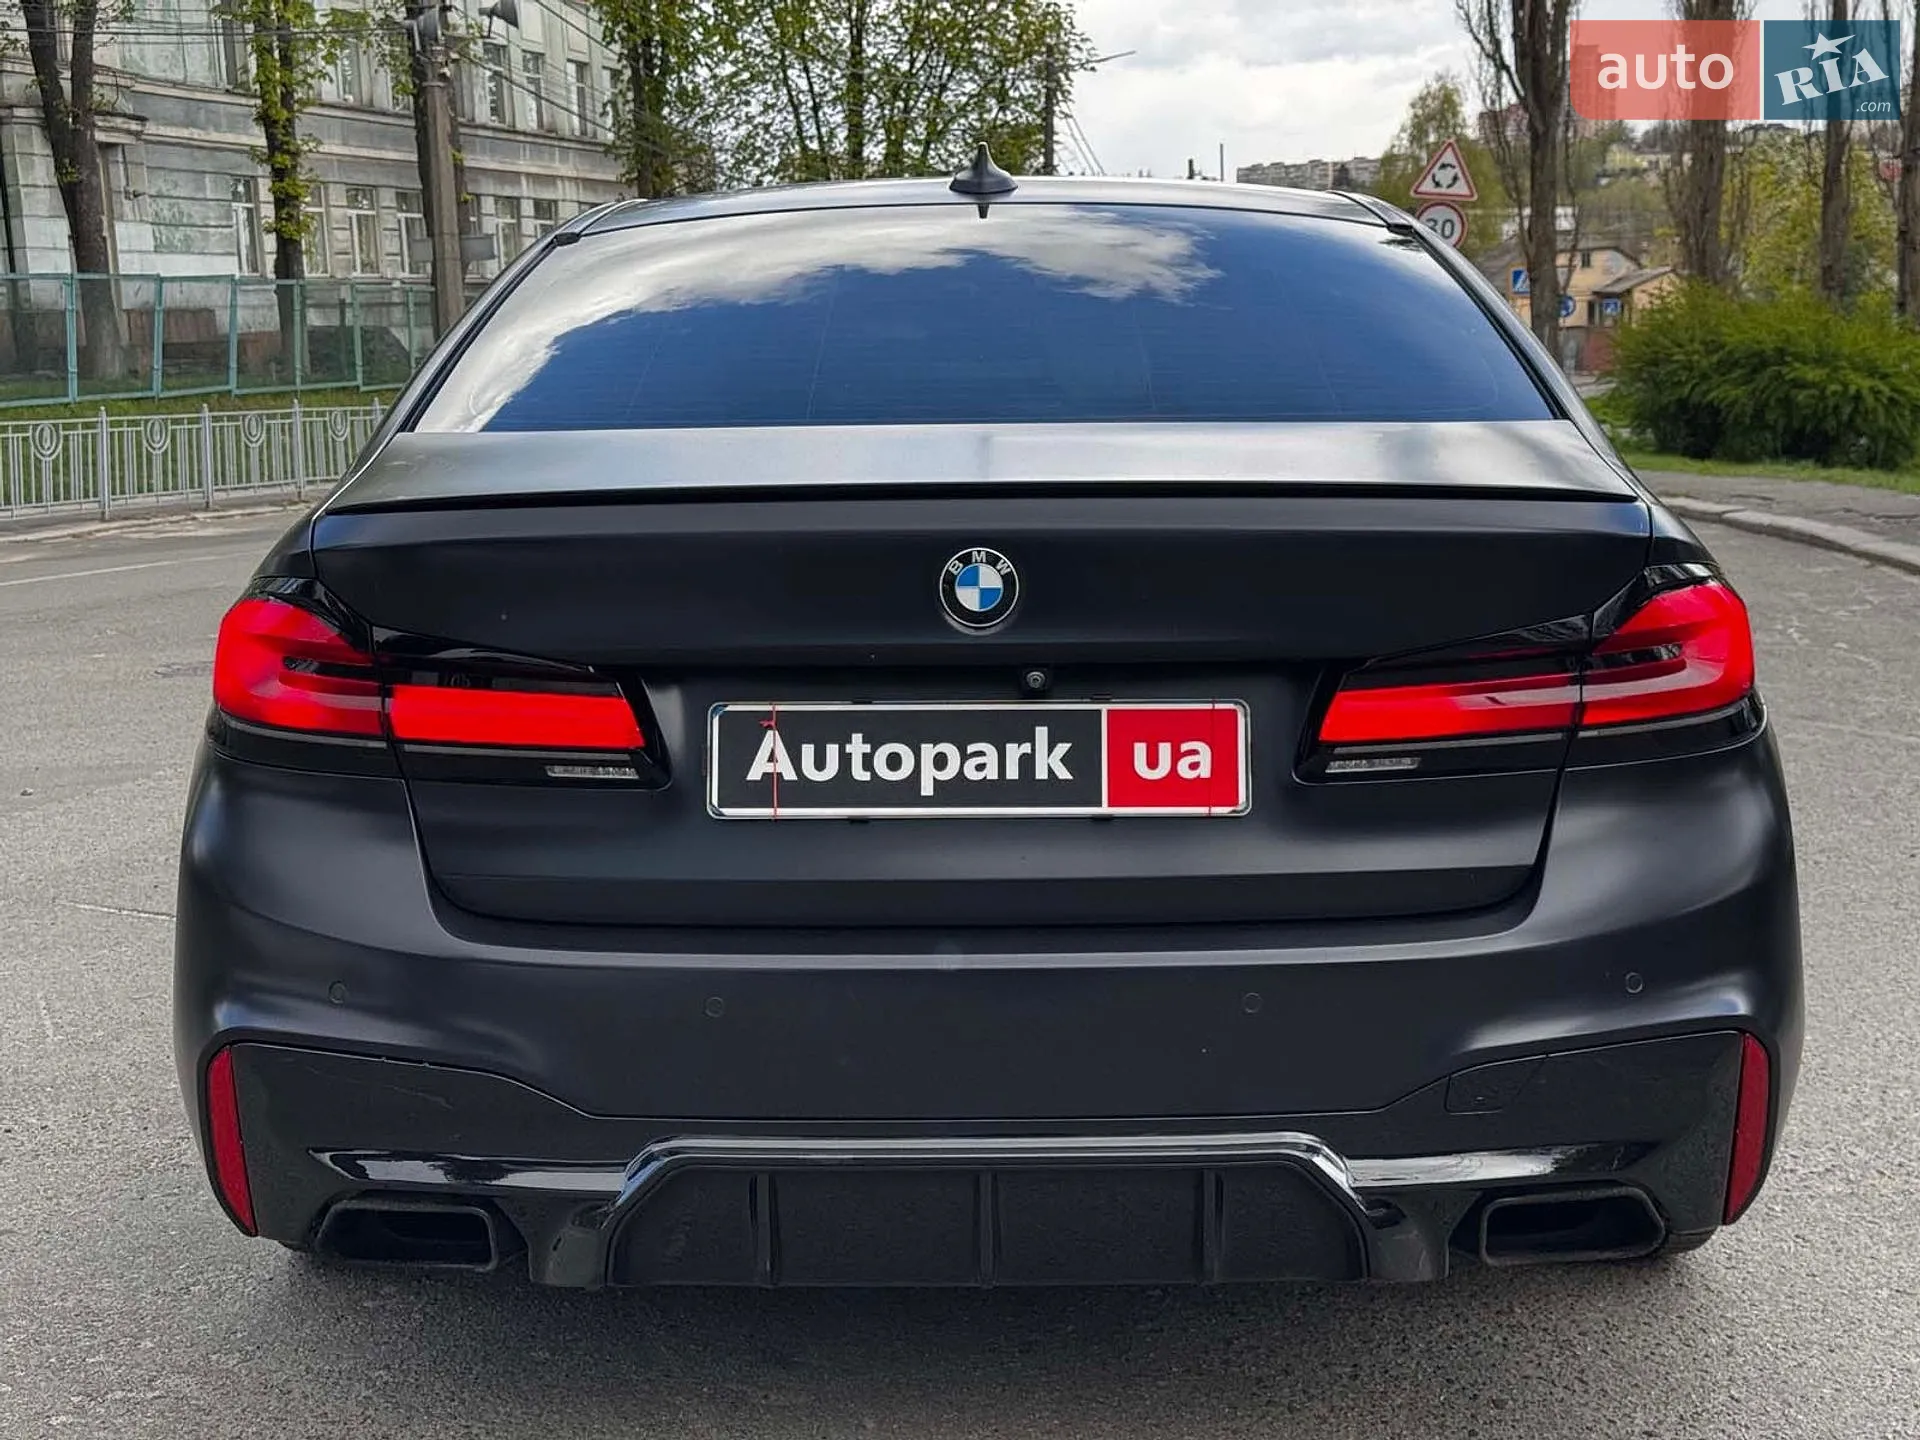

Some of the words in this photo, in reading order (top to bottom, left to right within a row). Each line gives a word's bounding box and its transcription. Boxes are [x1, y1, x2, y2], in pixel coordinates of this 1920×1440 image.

[948, 550, 1011, 576] BMW
[746, 726, 1074, 796] Autopark
[1133, 741, 1212, 779] ua
